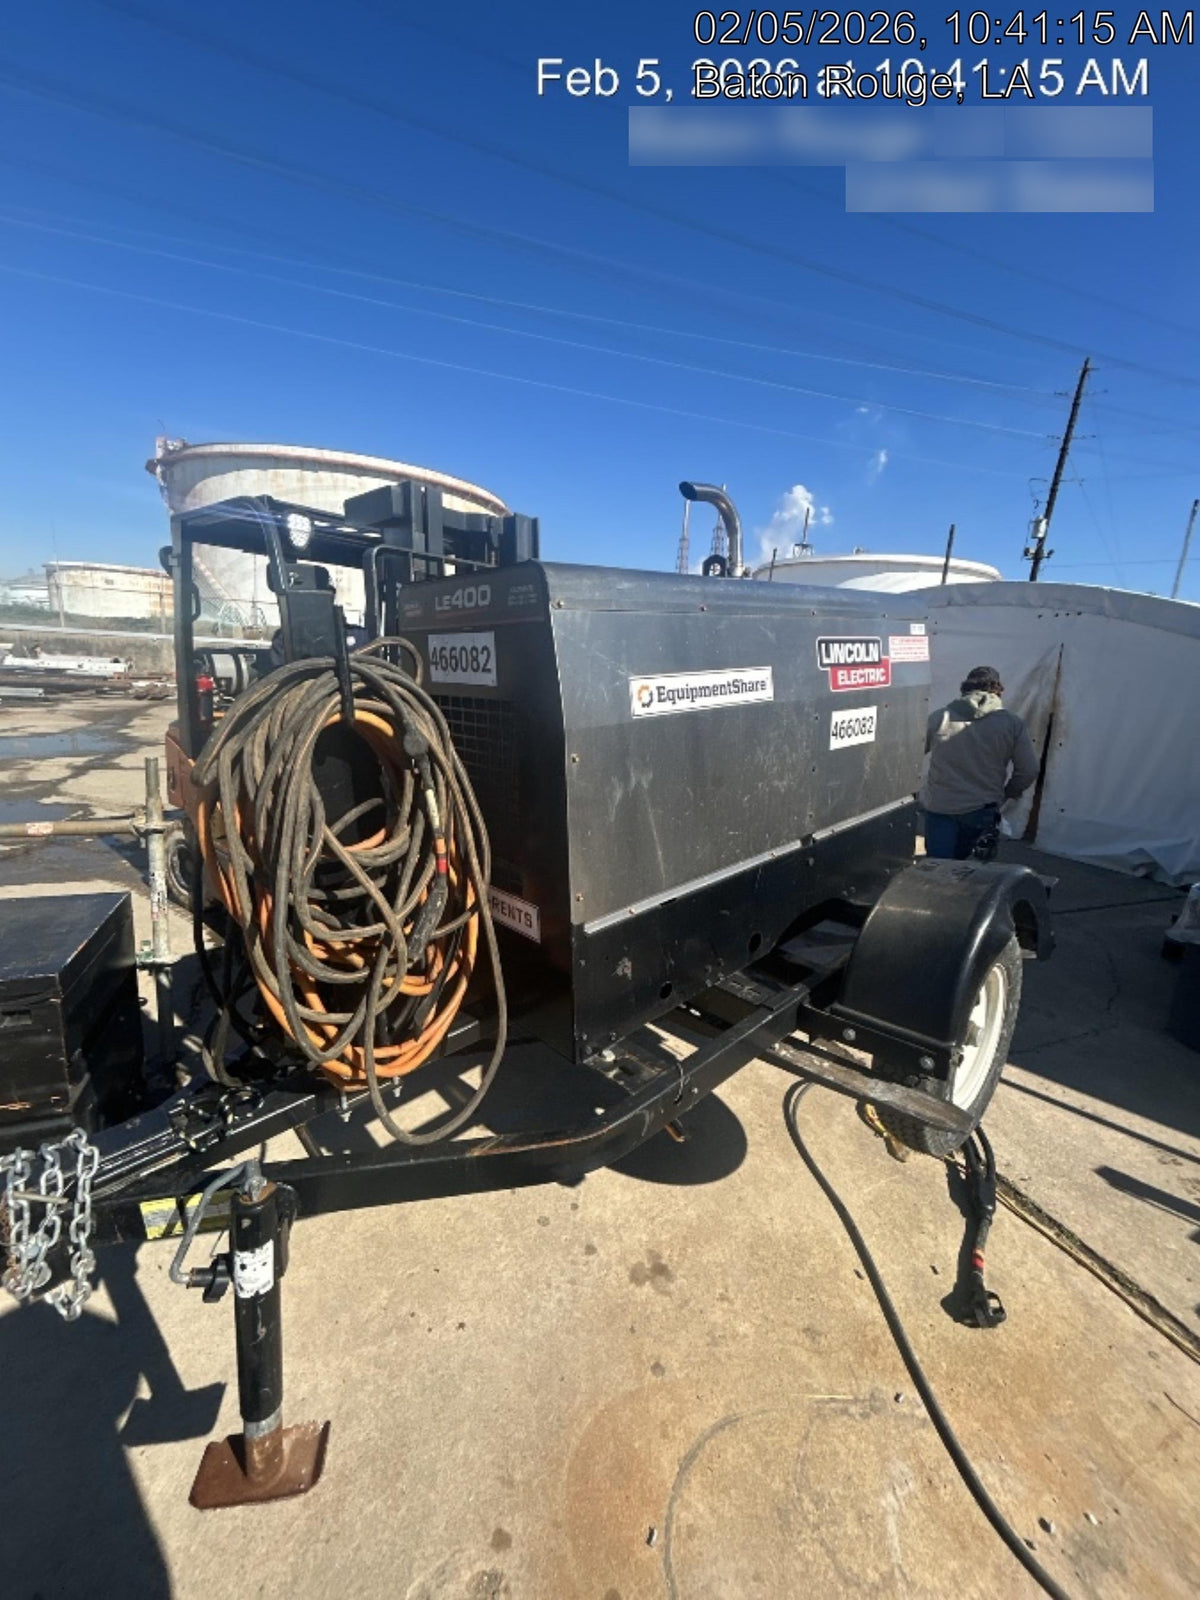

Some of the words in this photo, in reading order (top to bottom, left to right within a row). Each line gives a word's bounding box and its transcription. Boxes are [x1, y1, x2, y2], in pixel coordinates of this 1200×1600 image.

[434, 585, 491, 611] LE400
[430, 645, 492, 673] 466082
[821, 643, 880, 664] LINCOLN
[837, 668, 886, 685] ELECTRIC
[656, 678, 767, 704] EquipmentShare
[831, 716, 874, 740] 466082
